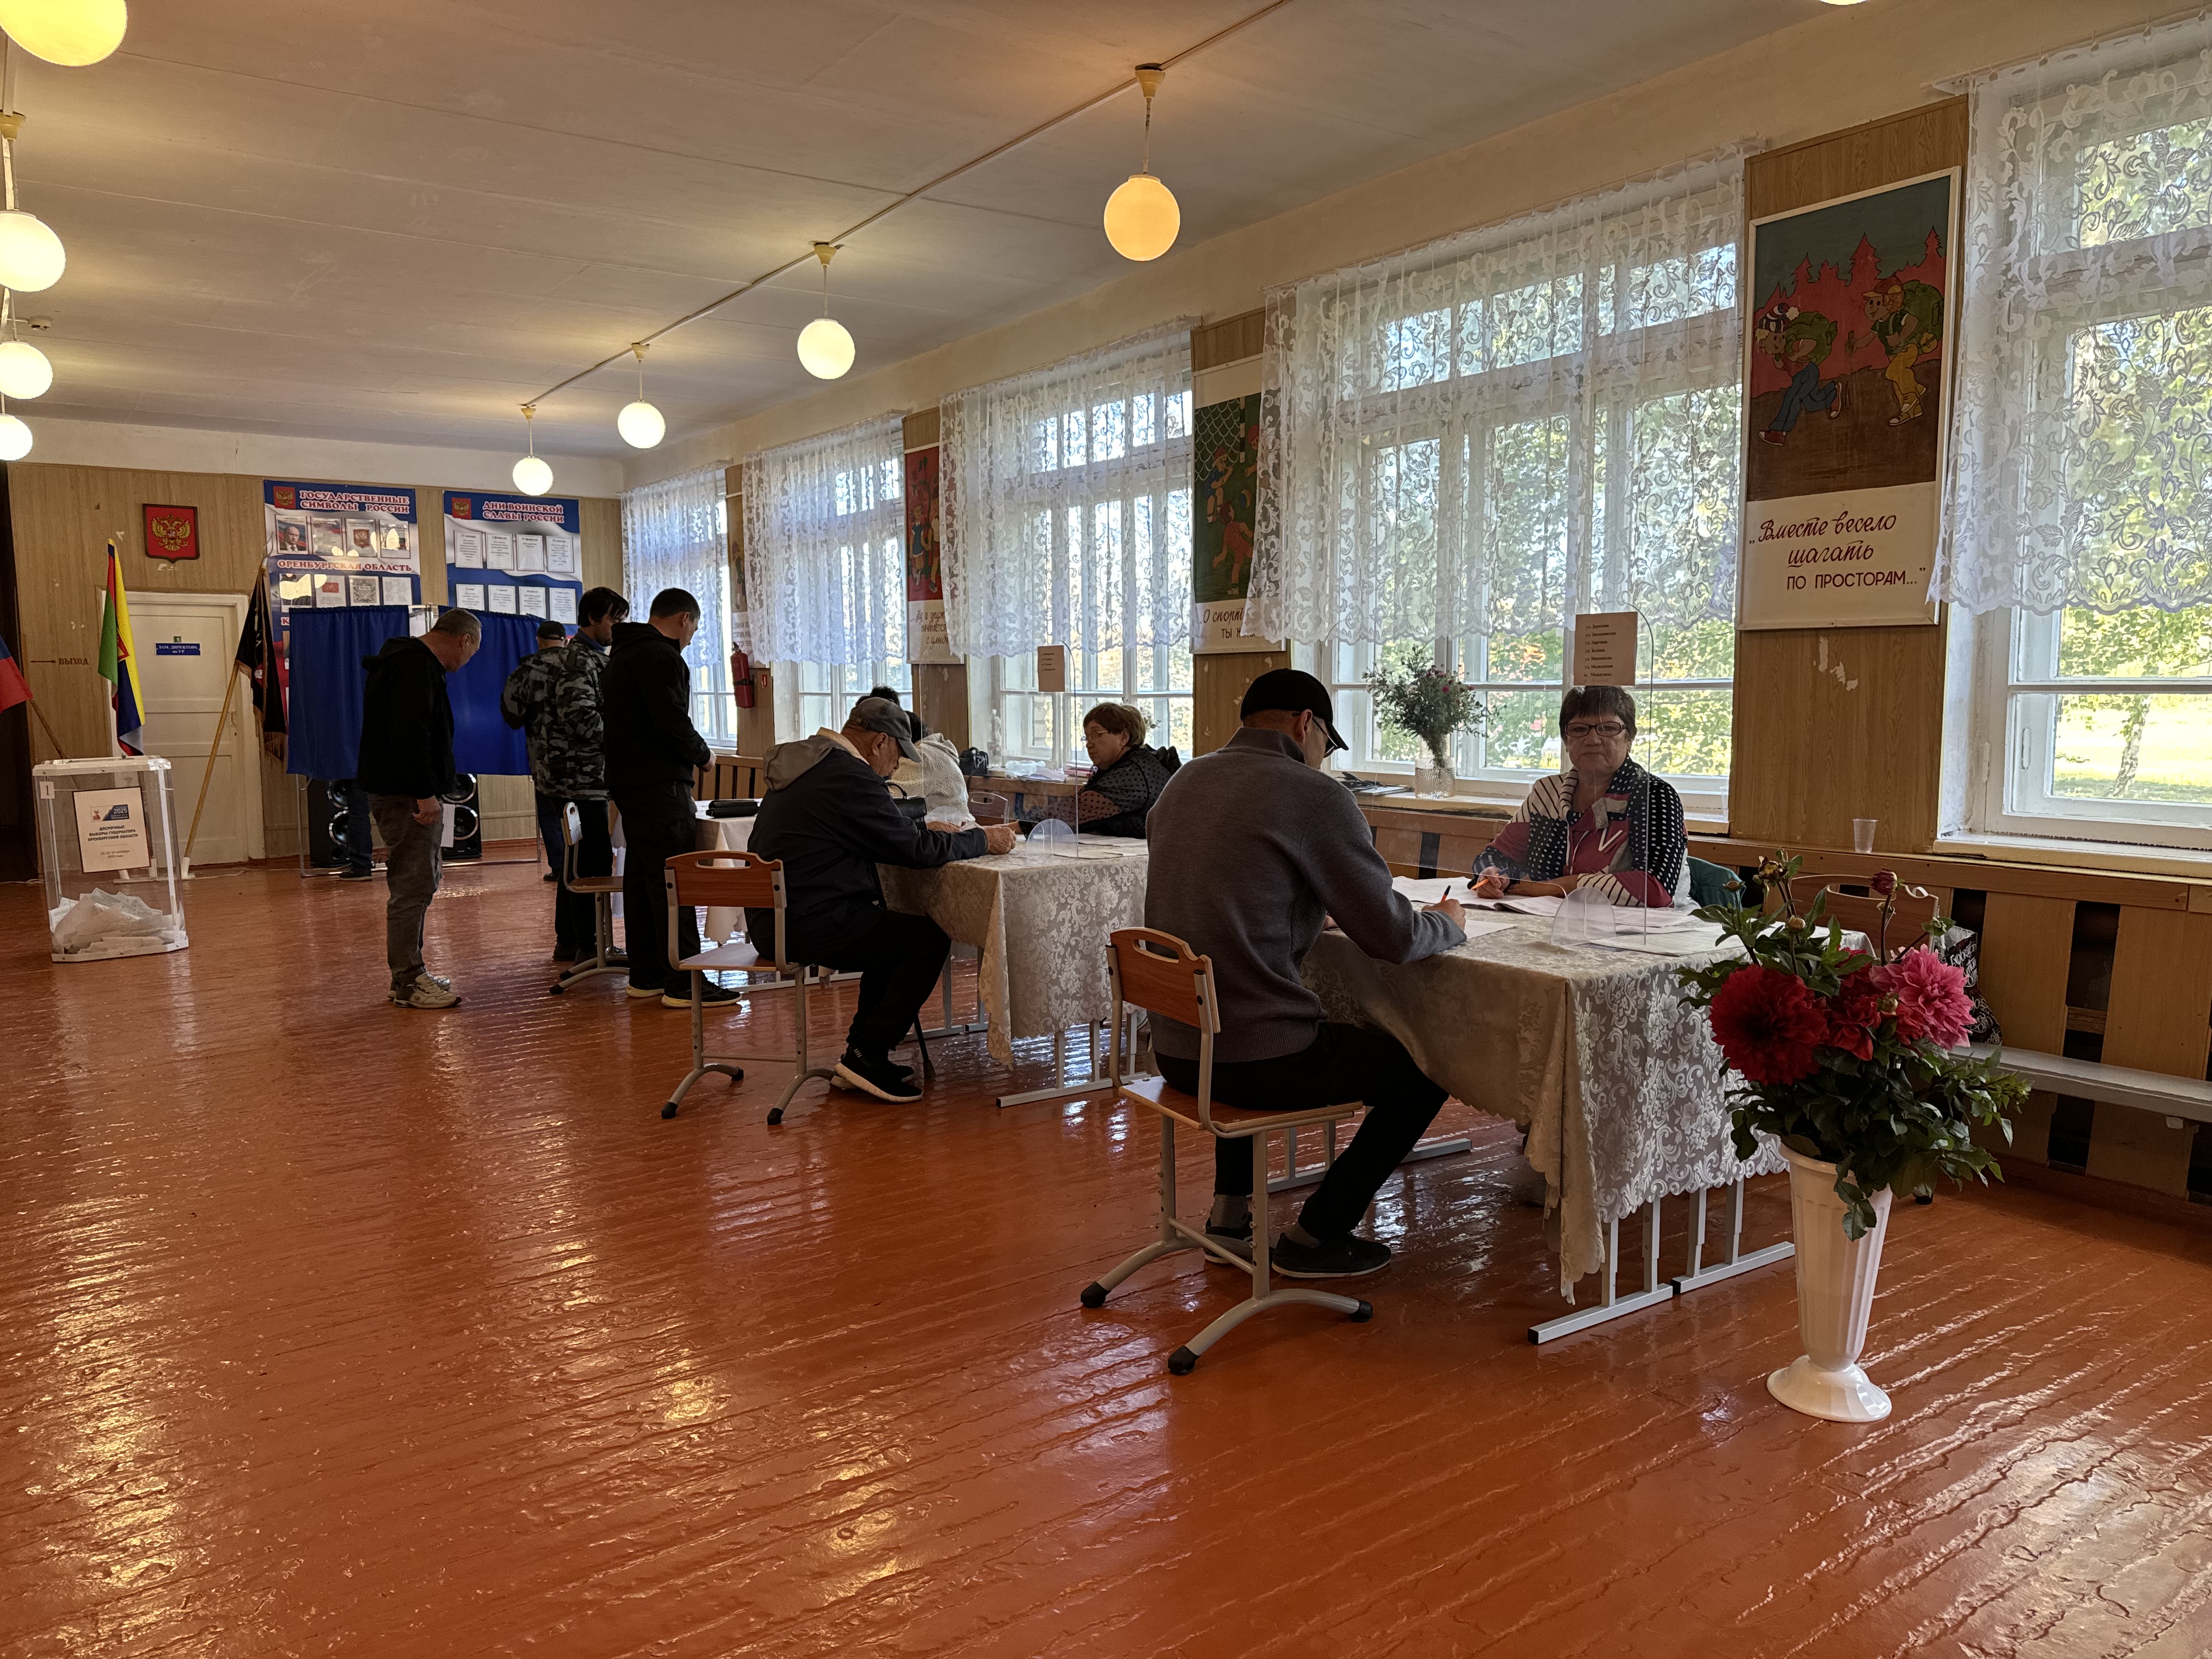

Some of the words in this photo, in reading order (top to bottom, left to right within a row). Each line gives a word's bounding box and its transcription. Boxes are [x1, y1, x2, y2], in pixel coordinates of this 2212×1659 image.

[299, 490, 410, 505] ГОСУДАРСТВЕННЫЕ
[300, 501, 359, 511] СИМВОЛЫ
[365, 505, 410, 514] РОССИИ
[482, 501, 506, 510] ДНИ
[507, 503, 563, 514] ВОИНСКОЙ
[483, 511, 522, 520] СЛАВЫ
[523, 514, 565, 523] РОССИИ
[1831, 511, 1897, 535] весело
[1787, 540, 1874, 568] шагать
[277, 560, 362, 571] ОРЕНБУРГСКАЯ
[362, 563, 412, 572] ОБЛАСТЬ
[1787, 575, 1807, 591] ПО
[46, 785, 50, 795] 1
